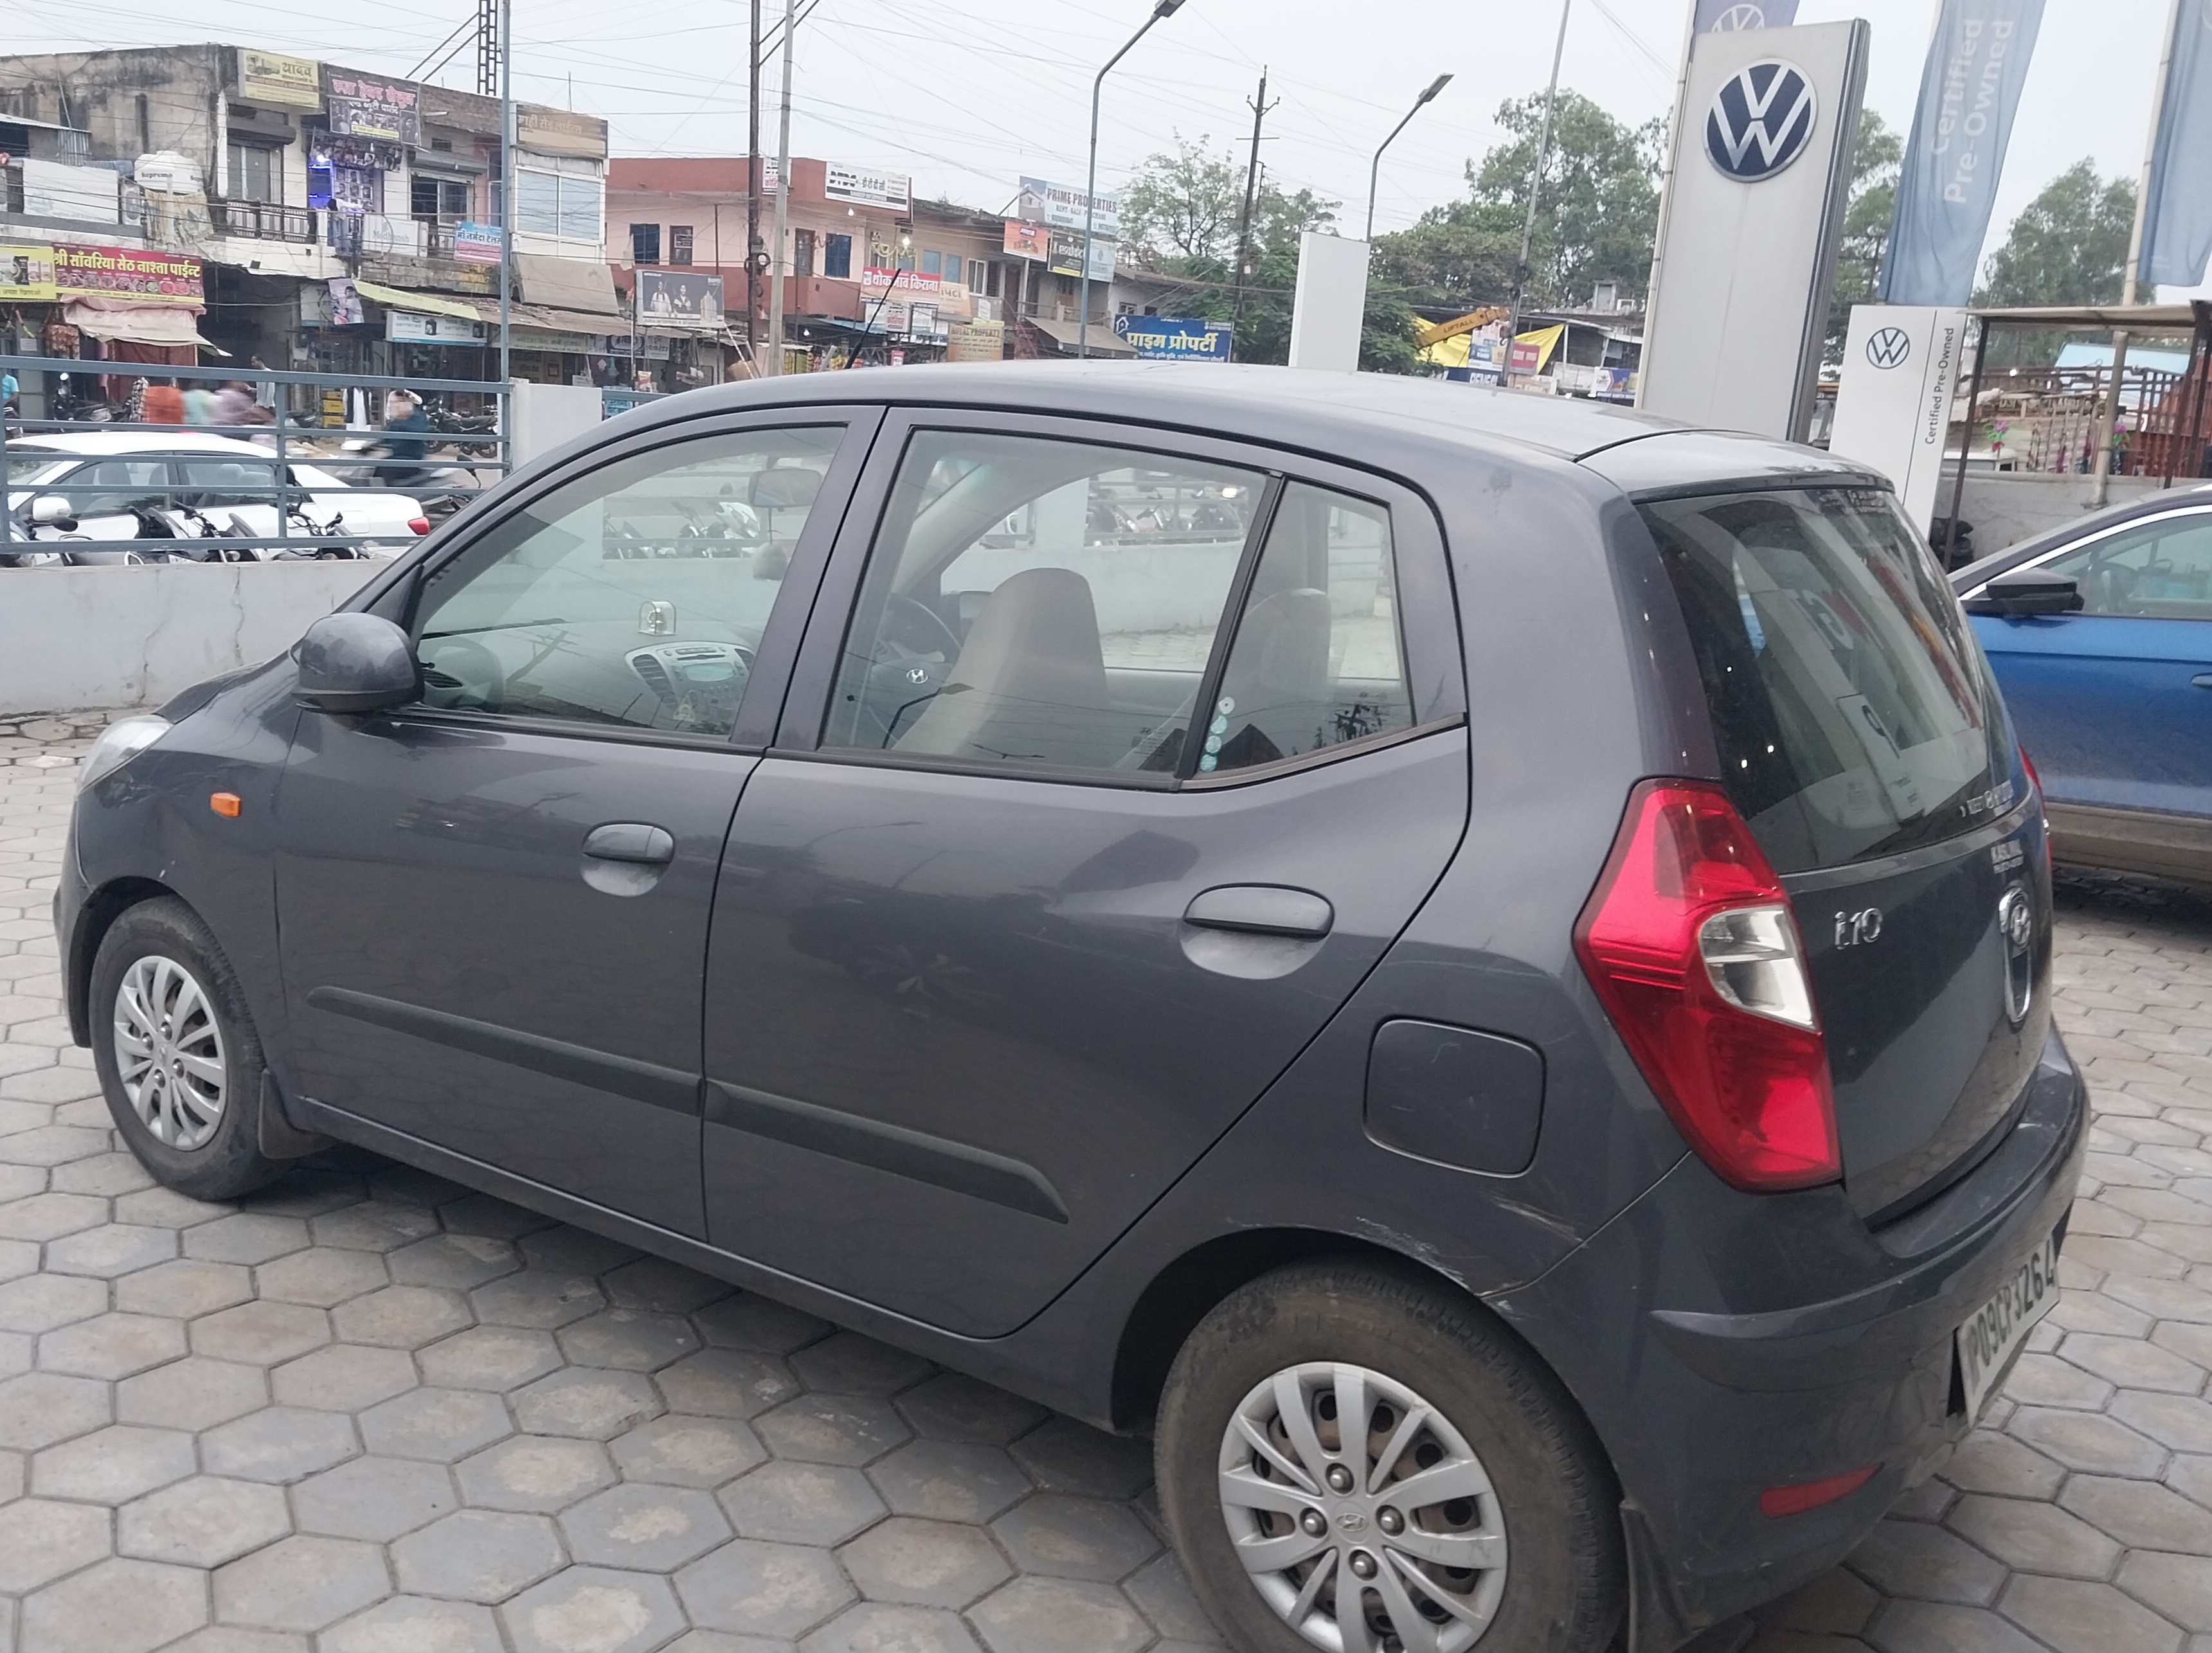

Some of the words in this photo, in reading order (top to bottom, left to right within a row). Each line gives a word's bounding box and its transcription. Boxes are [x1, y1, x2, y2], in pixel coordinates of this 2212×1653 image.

[282, 62, 312, 76] यादव
[1930, 20, 1984, 155] Certified
[1943, 21, 2013, 203] Pre-Owned
[1047, 188, 1071, 204] PRIME
[1073, 193, 1117, 213] PROERTIES
[1084, 210, 1106, 220] PCHASE
[54, 248, 67, 266] श्री
[117, 254, 135, 273] सेठ
[910, 274, 939, 292] किराना
[1443, 319, 1472, 333] LIFTALL
[1126, 332, 1167, 349] प्राइम
[1168, 330, 1219, 352] प्रोपर्टी
[1934, 328, 1954, 393] Pre-Owned
[1925, 396, 1942, 445] Certified
[1834, 907, 1884, 950] i10
